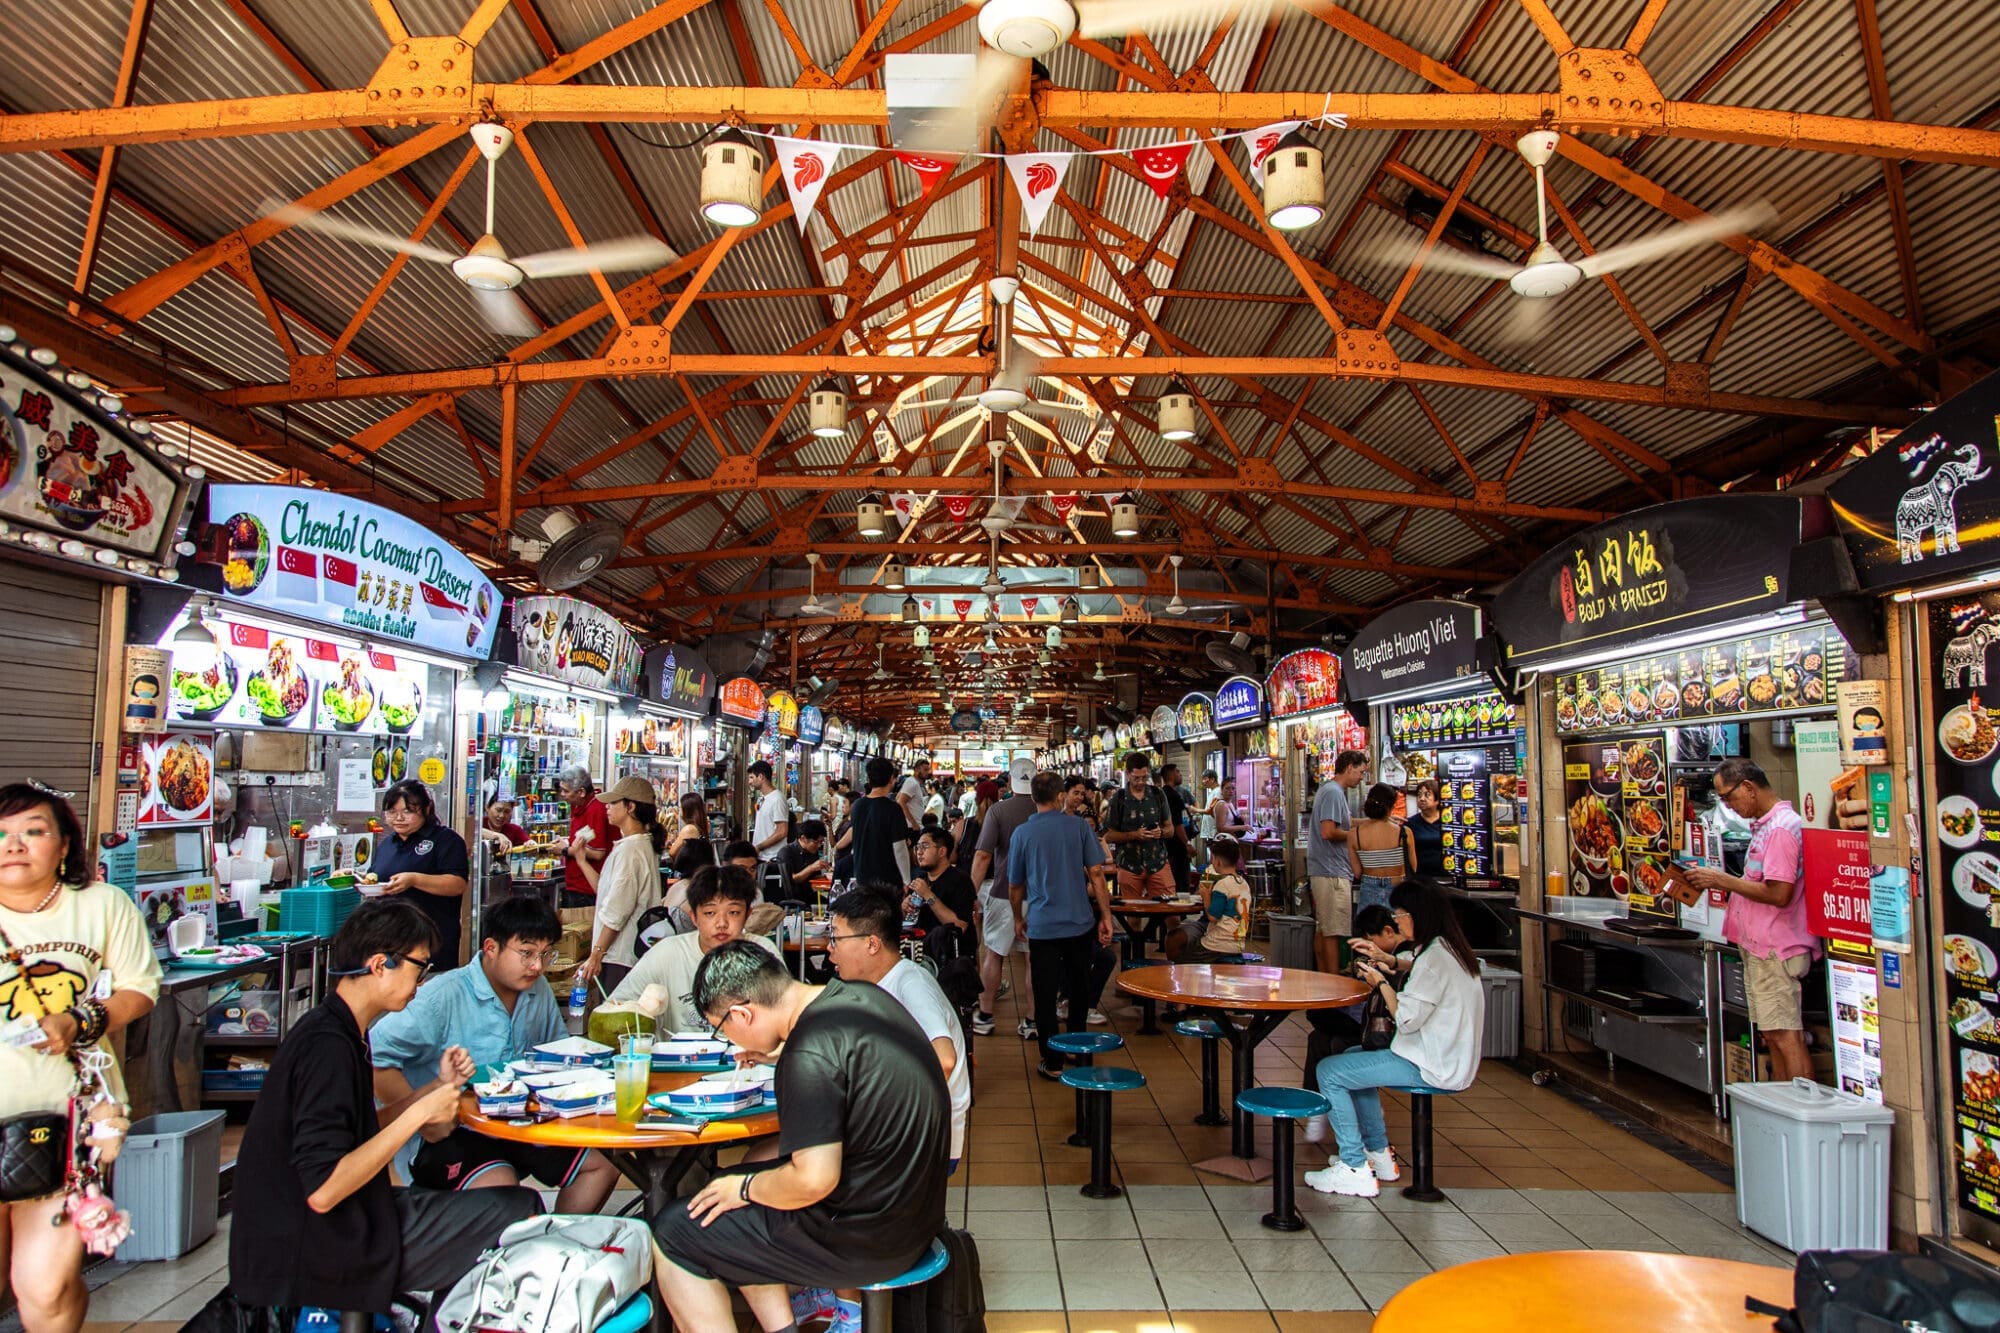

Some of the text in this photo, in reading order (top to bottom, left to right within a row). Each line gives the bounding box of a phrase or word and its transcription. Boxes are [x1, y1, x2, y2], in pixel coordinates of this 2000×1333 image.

[281, 499, 359, 554] Chendol
[360, 518, 423, 576] Coconut
[424, 546, 473, 605] Dessert
[1578, 598, 1606, 624] BOLD
[1620, 579, 1668, 613] BRAISED
[1353, 638, 1394, 672] Baguette
[1393, 626, 1431, 656] Huong
[1429, 614, 1457, 646] Viet
[595, 655, 609, 673] CAFE
[1380, 659, 1426, 681] Vietnamese Cuisine
[1838, 864, 1871, 878] carna
[1823, 891, 1852, 921] $6.50
